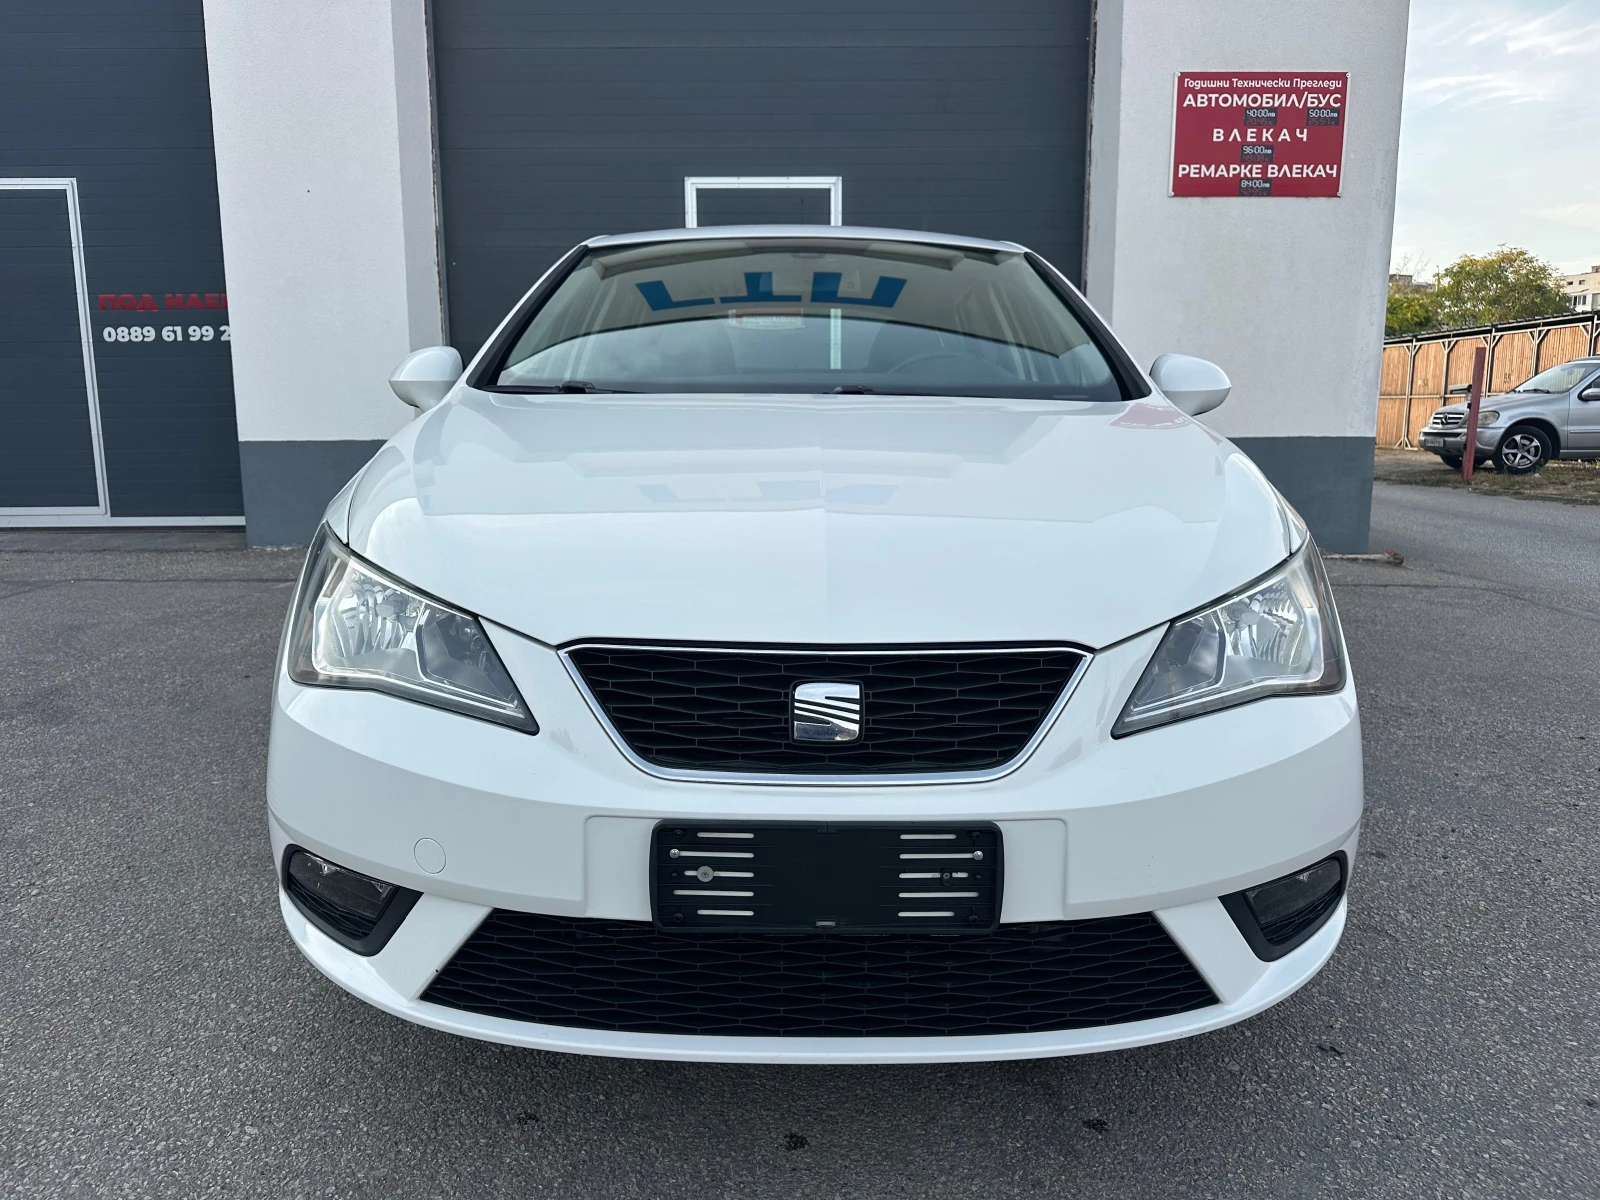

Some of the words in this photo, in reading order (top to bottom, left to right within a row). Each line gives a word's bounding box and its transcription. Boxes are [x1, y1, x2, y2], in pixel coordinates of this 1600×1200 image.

[1184, 78, 1230, 89] Годишни
[1231, 78, 1291, 89] Технически
[1292, 78, 1342, 89] Прегледи
[1182, 91, 1342, 109] АВТОМОБИЛ/БУС
[1177, 164, 1263, 178] РЕМАРКЕ
[1267, 164, 1338, 178] ВЛЕКАЧ
[98, 293, 159, 312] ПОД
[102, 326, 156, 342] 0889
[161, 325, 183, 342] 61
[187, 325, 215, 342] 99
